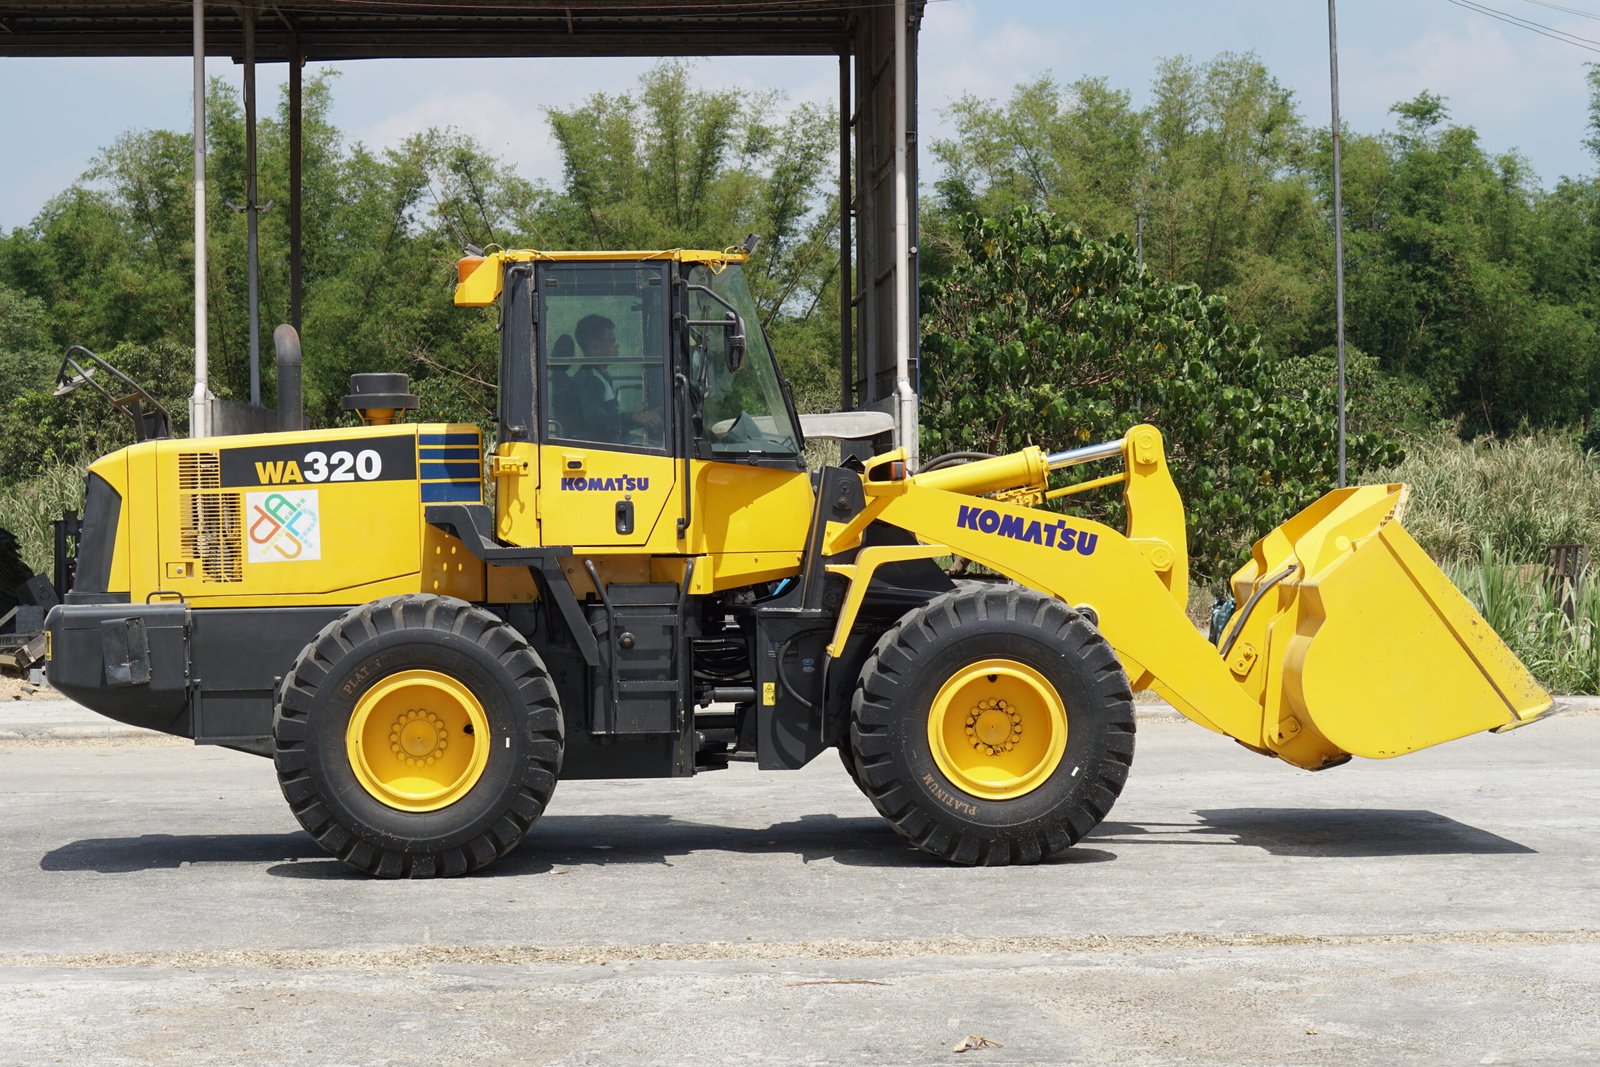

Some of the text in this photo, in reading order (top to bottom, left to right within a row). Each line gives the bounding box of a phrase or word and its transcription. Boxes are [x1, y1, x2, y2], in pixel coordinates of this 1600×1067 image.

[255, 449, 382, 485] WA320
[561, 474, 649, 491] KOMATSU
[957, 505, 1098, 556] KOMATSU
[922, 773, 977, 816] PLATINUM
